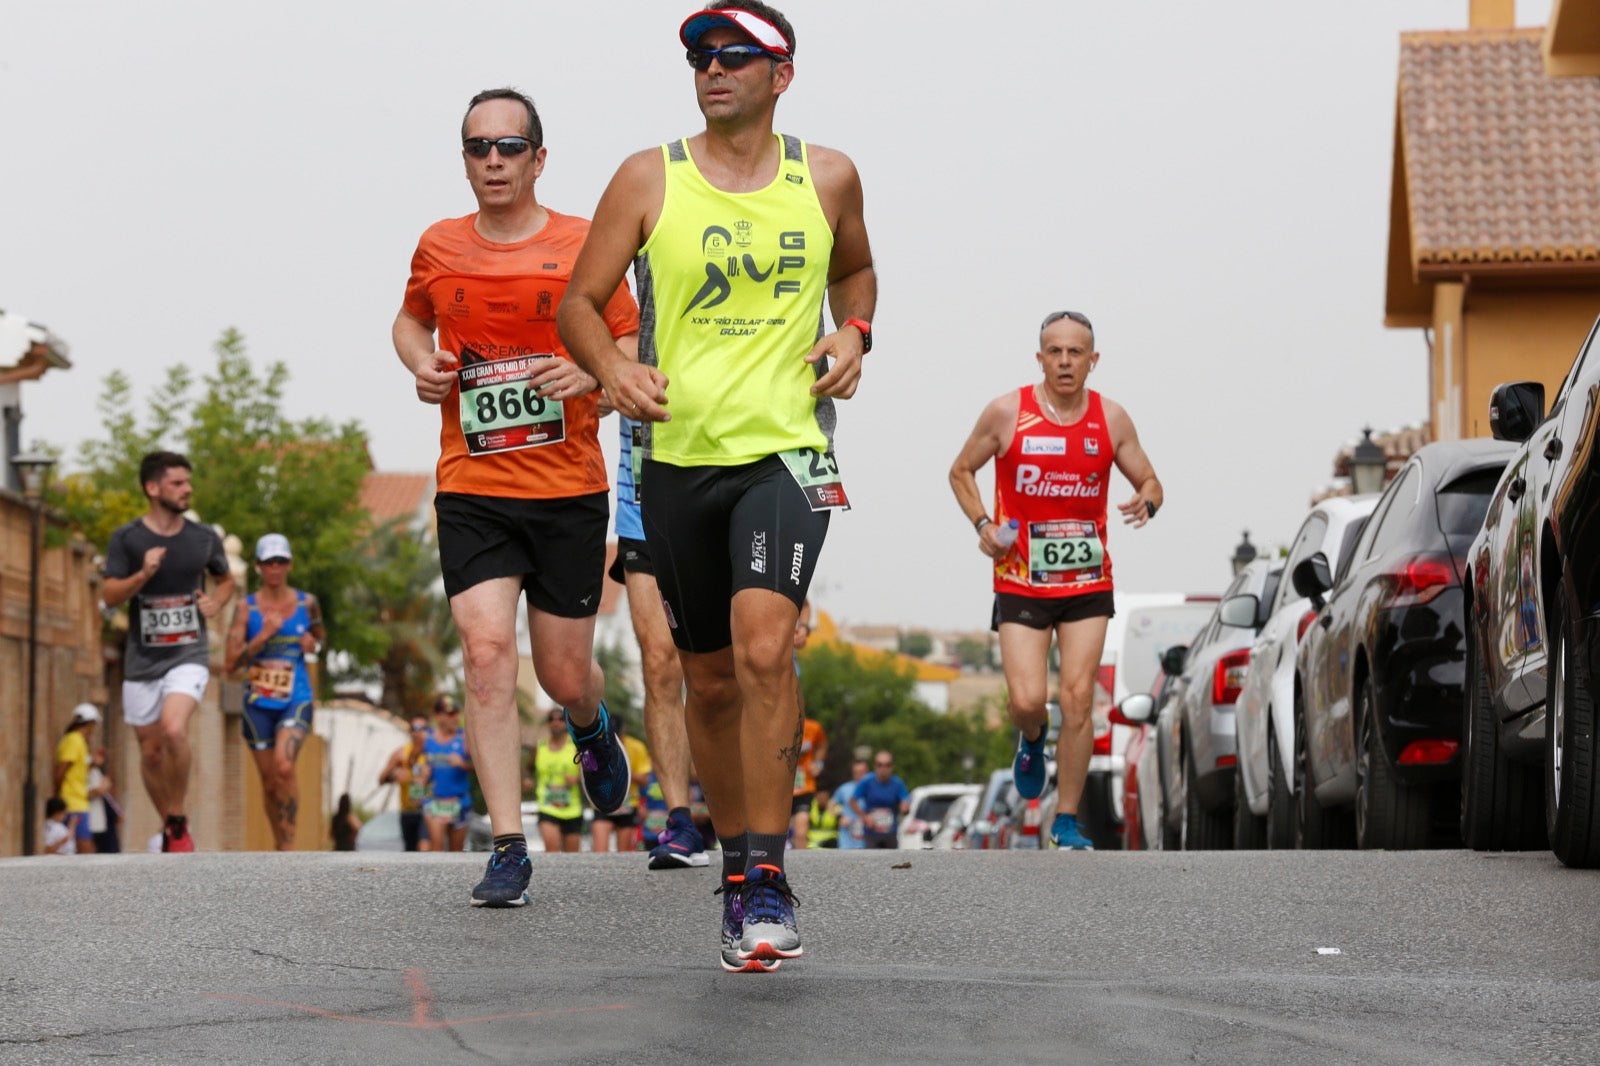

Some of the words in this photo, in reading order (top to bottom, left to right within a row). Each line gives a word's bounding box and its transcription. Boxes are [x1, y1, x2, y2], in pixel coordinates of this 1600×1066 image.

[691, 317, 711, 325] XXX
[720, 327, 758, 336] GÓJAR
[476, 364, 495, 377] GRAN
[494, 361, 519, 376] PREMIO
[519, 359, 527, 370] DE
[475, 387, 546, 424] 866
[1015, 463, 1101, 497] Polisalud
[753, 530, 763, 559] PACC
[1043, 541, 1093, 565] 623
[149, 609, 193, 628] 3039
